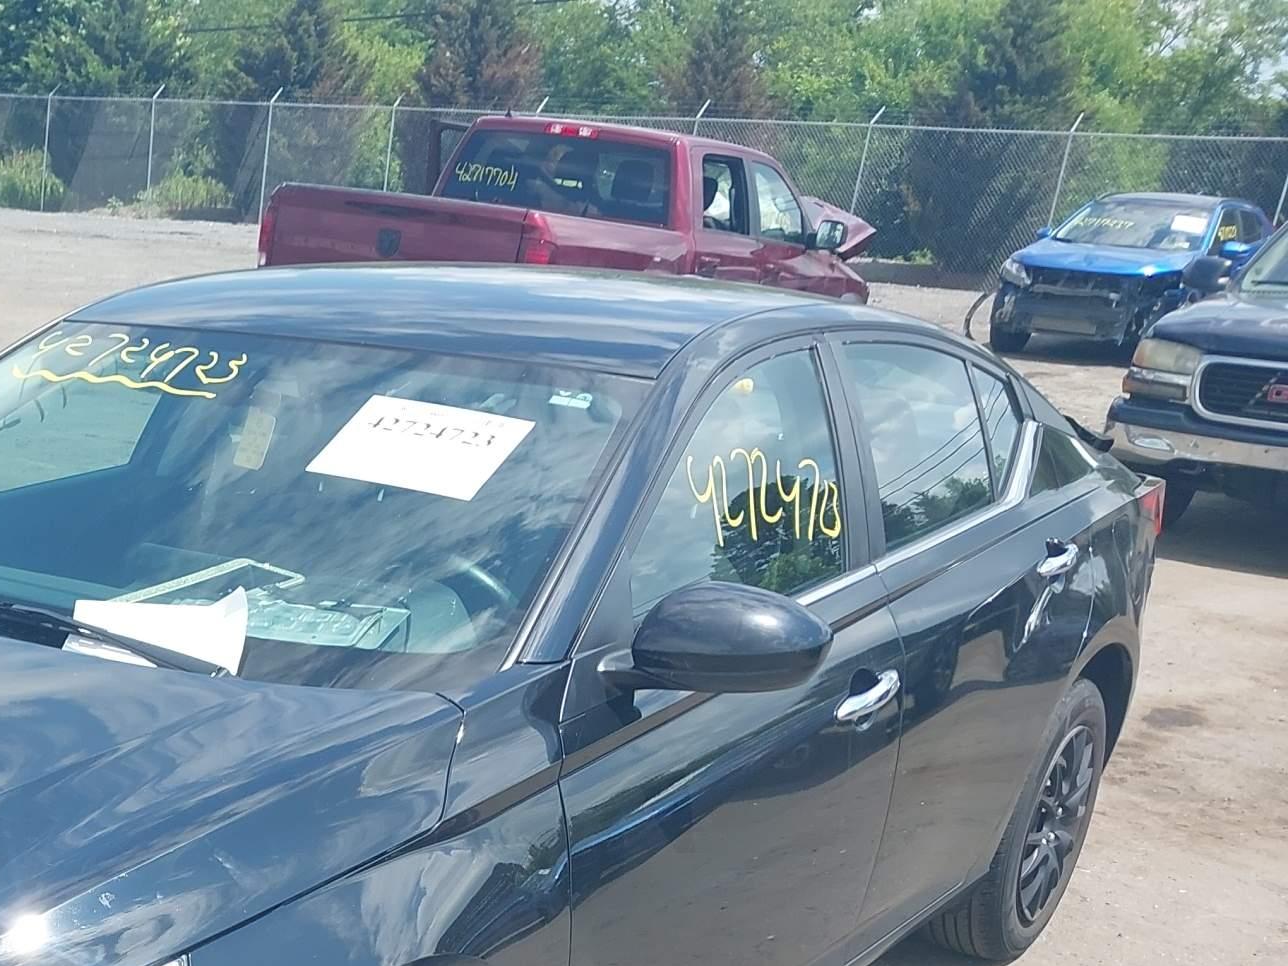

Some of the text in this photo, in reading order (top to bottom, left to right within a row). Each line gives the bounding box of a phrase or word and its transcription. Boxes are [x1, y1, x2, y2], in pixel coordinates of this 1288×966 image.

[455, 161, 518, 191] 42717704
[32, 331, 248, 384] 42724723
[368, 416, 496, 447] 42724723
